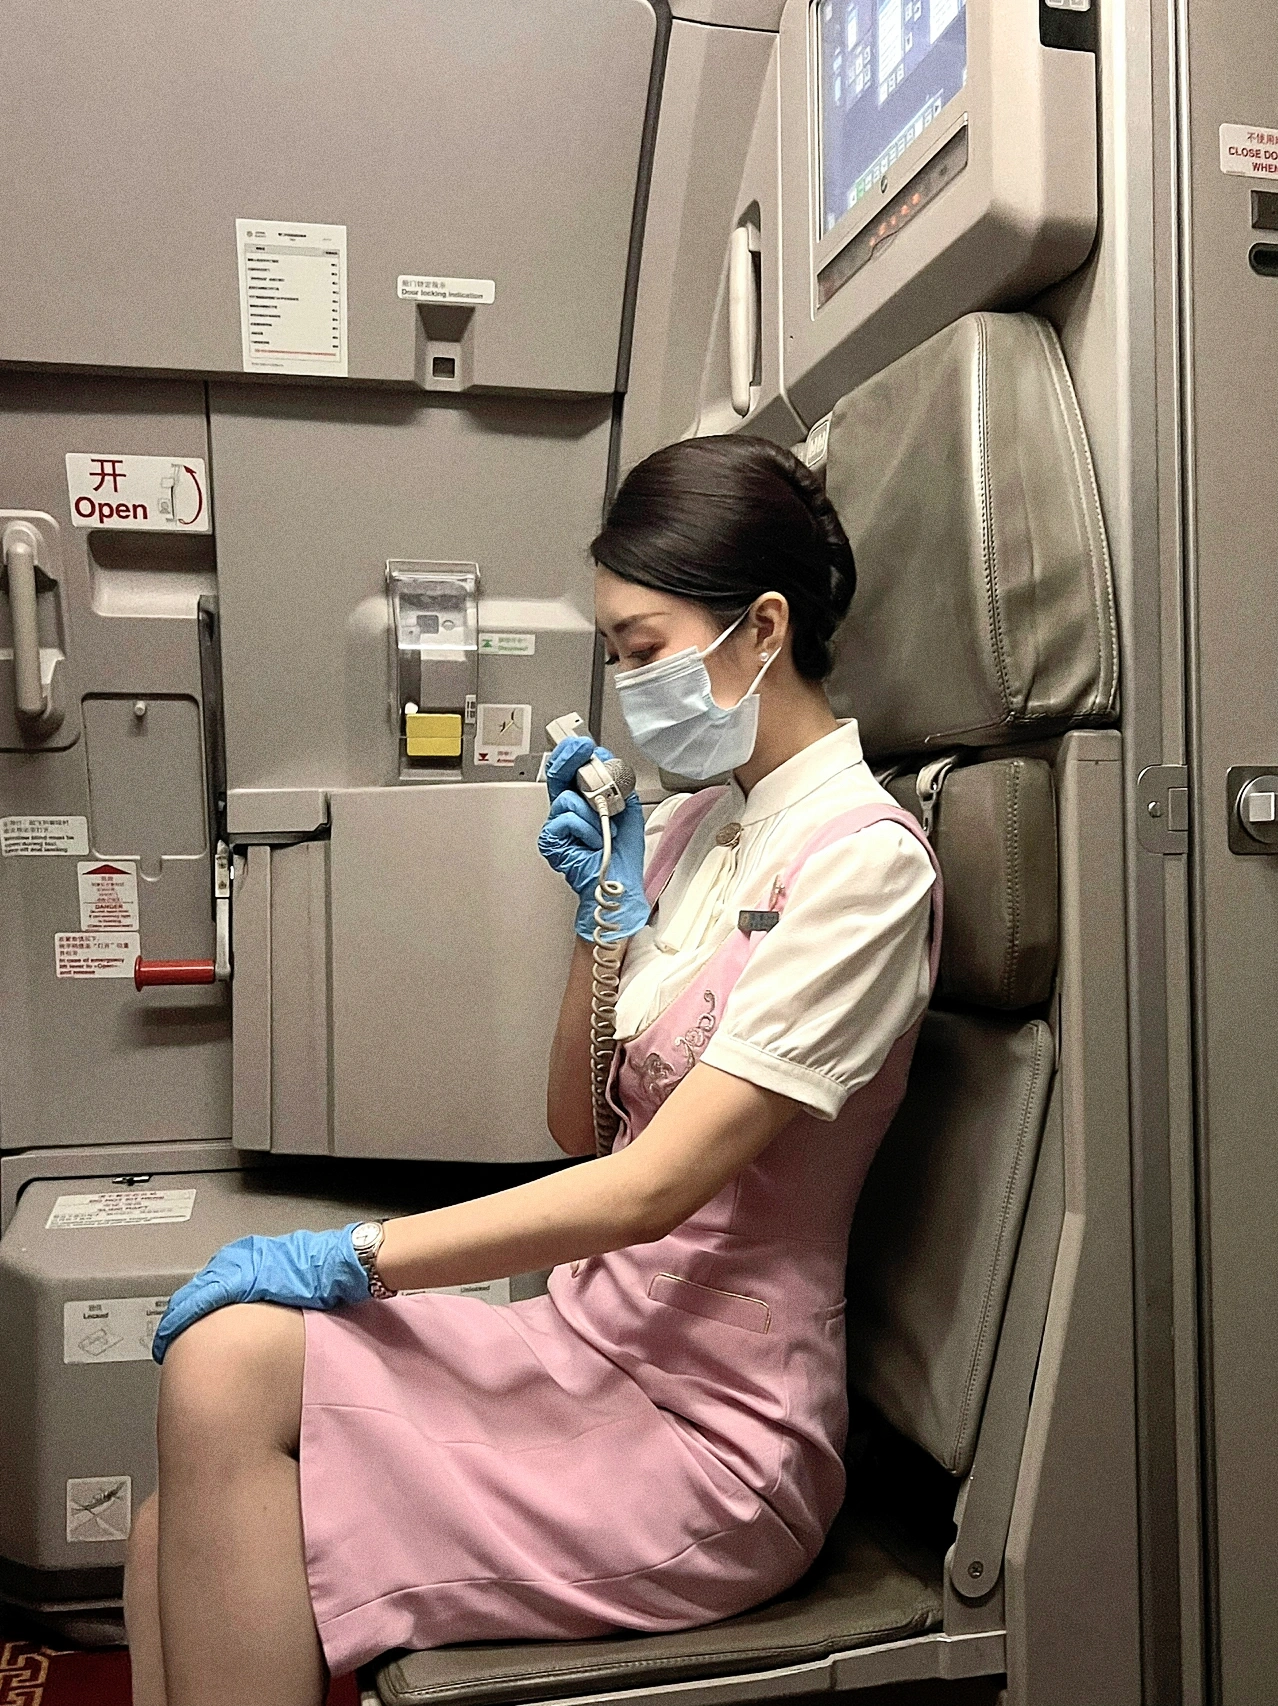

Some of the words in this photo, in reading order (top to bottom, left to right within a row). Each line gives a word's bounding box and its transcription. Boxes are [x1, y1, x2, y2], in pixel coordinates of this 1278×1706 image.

[1229, 146, 1262, 158] CLOSE
[89, 458, 126, 493] 开
[74, 496, 148, 524] Open
